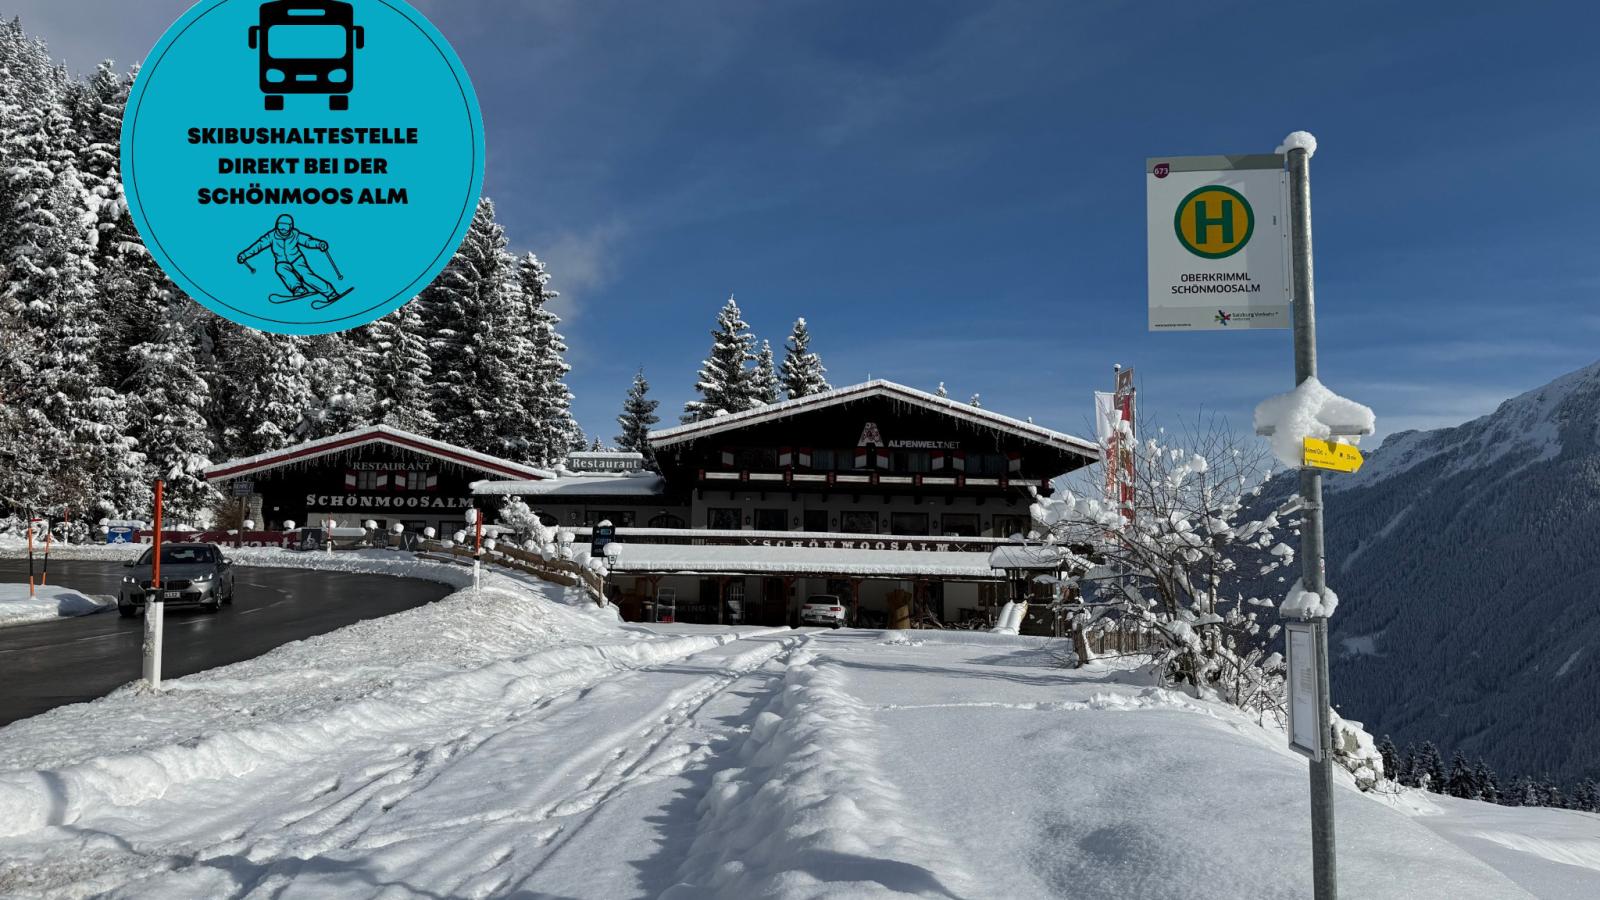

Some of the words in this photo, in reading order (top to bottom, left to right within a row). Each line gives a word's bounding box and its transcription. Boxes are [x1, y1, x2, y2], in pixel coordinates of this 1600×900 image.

[1154, 167, 1169, 175] 673
[1195, 199, 1234, 244] H
[1180, 272, 1251, 282] OBERKRIMML
[1171, 283, 1261, 294] SCHÖNMOOSALM
[888, 440, 960, 449] ALPENWELT.NET
[353, 462, 432, 471] RESTAURANT
[573, 458, 638, 468] Restaurant
[306, 494, 474, 508] SCHÖNMOOSALM
